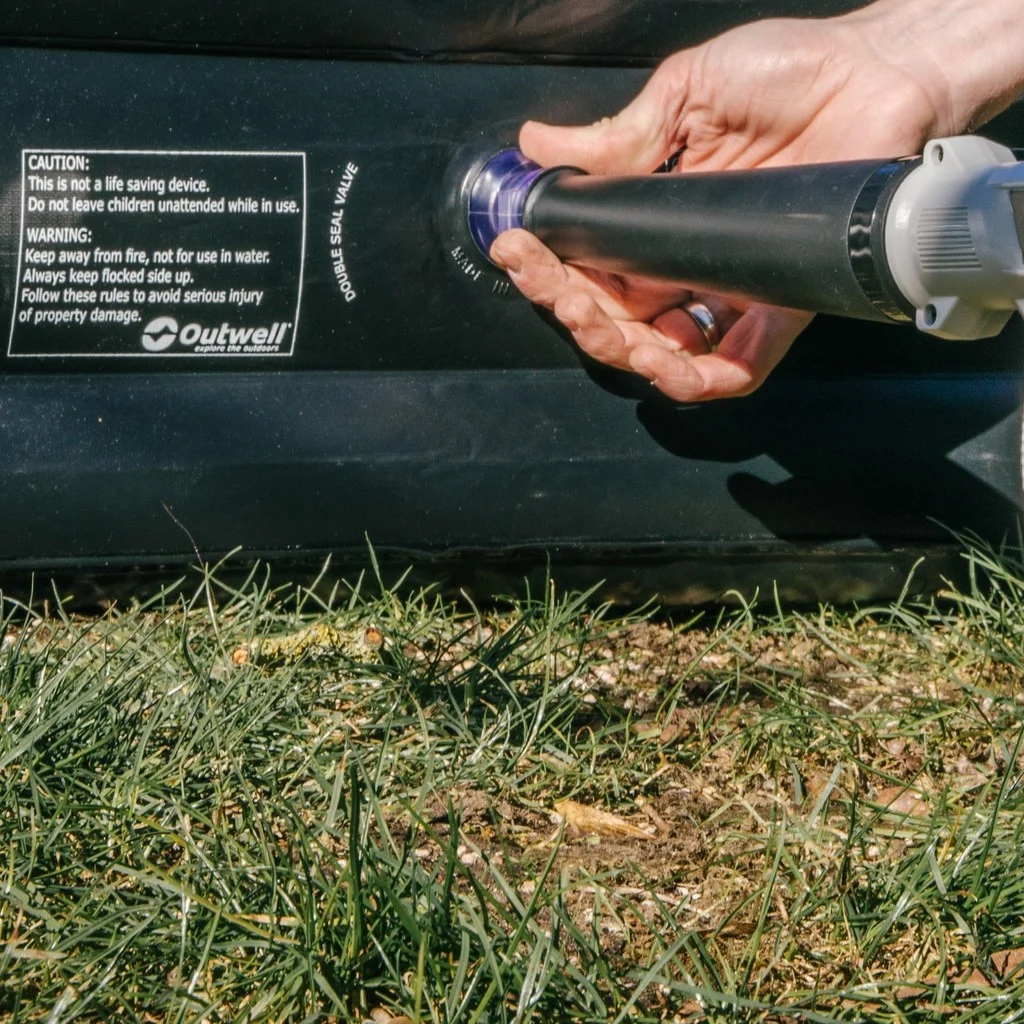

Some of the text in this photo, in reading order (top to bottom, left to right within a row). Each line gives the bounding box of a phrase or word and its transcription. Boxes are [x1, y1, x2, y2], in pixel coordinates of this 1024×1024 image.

[28, 155, 90, 171] CAUTION:
[28, 175, 210, 195] This is not a life saving device.
[28, 196, 300, 214] Do not leave children unattended while in use.
[26, 227, 93, 244] WARNING:
[329, 161, 359, 303] DOUBLE SEAL VALVE
[25, 247, 270, 266] Keep away from fire, not for use in water.
[22, 267, 194, 287] Always keep flocked side up.
[21, 288, 264, 306] Follow these rules to avoid serious injury
[19, 307, 142, 325] of property damage.
[179, 322, 288, 346] Outwell
[194, 344, 280, 354] explore the outdoors
